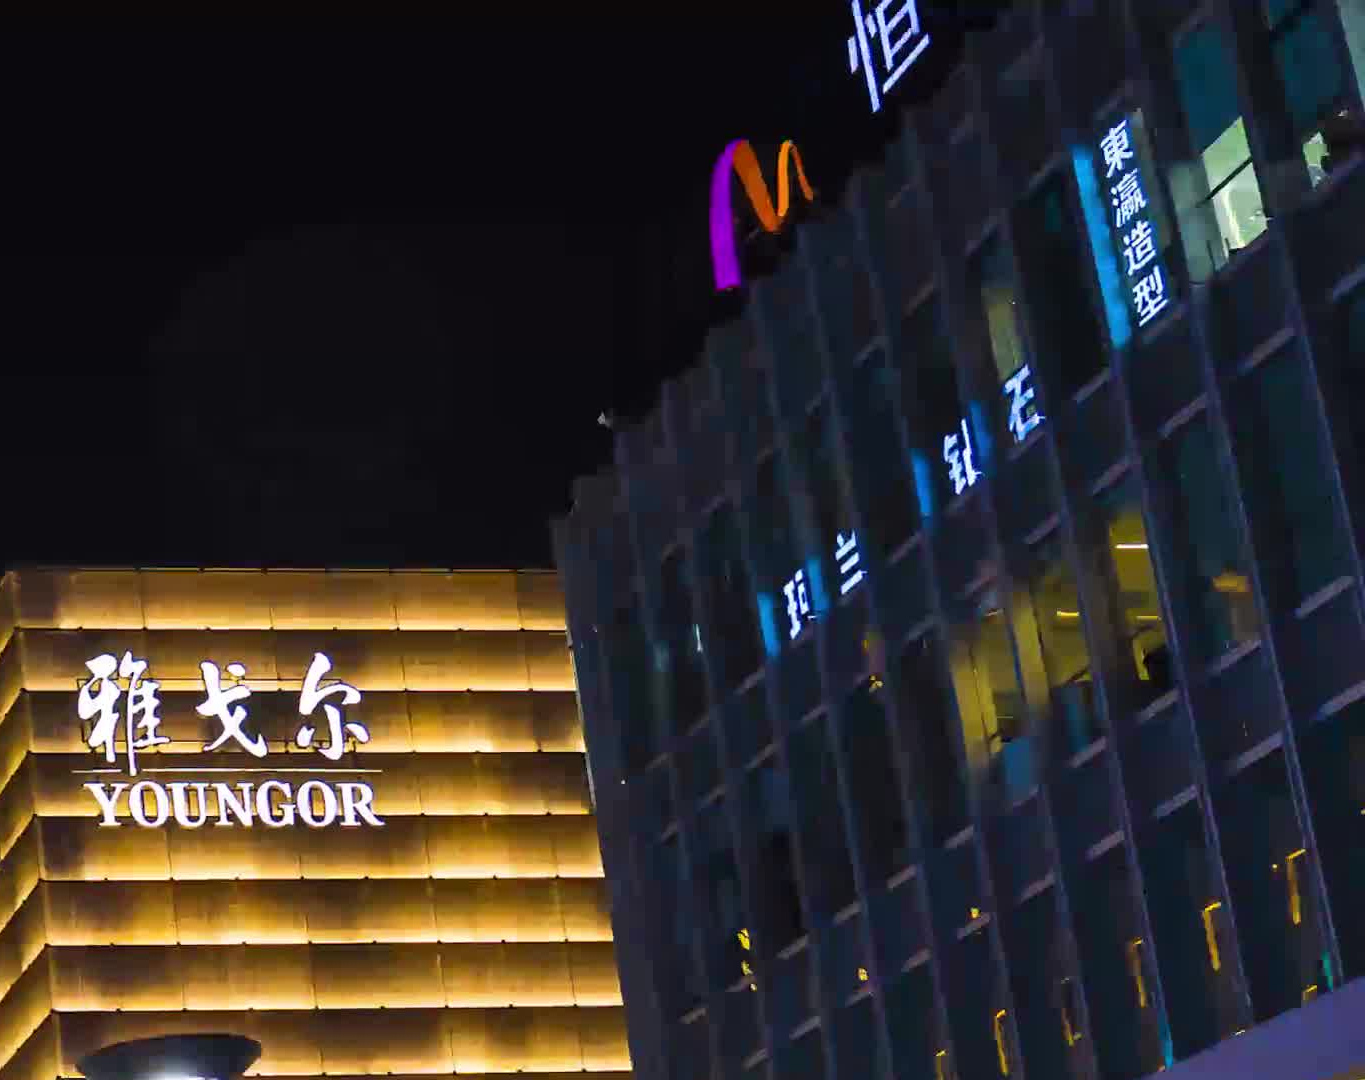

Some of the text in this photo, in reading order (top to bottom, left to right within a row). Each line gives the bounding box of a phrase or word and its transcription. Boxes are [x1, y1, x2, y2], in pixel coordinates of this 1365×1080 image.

[1100, 120, 1168, 328] 東瀛造型
[78, 651, 371, 776] 雅戈尔
[84, 780, 386, 828] YOUNGOR
